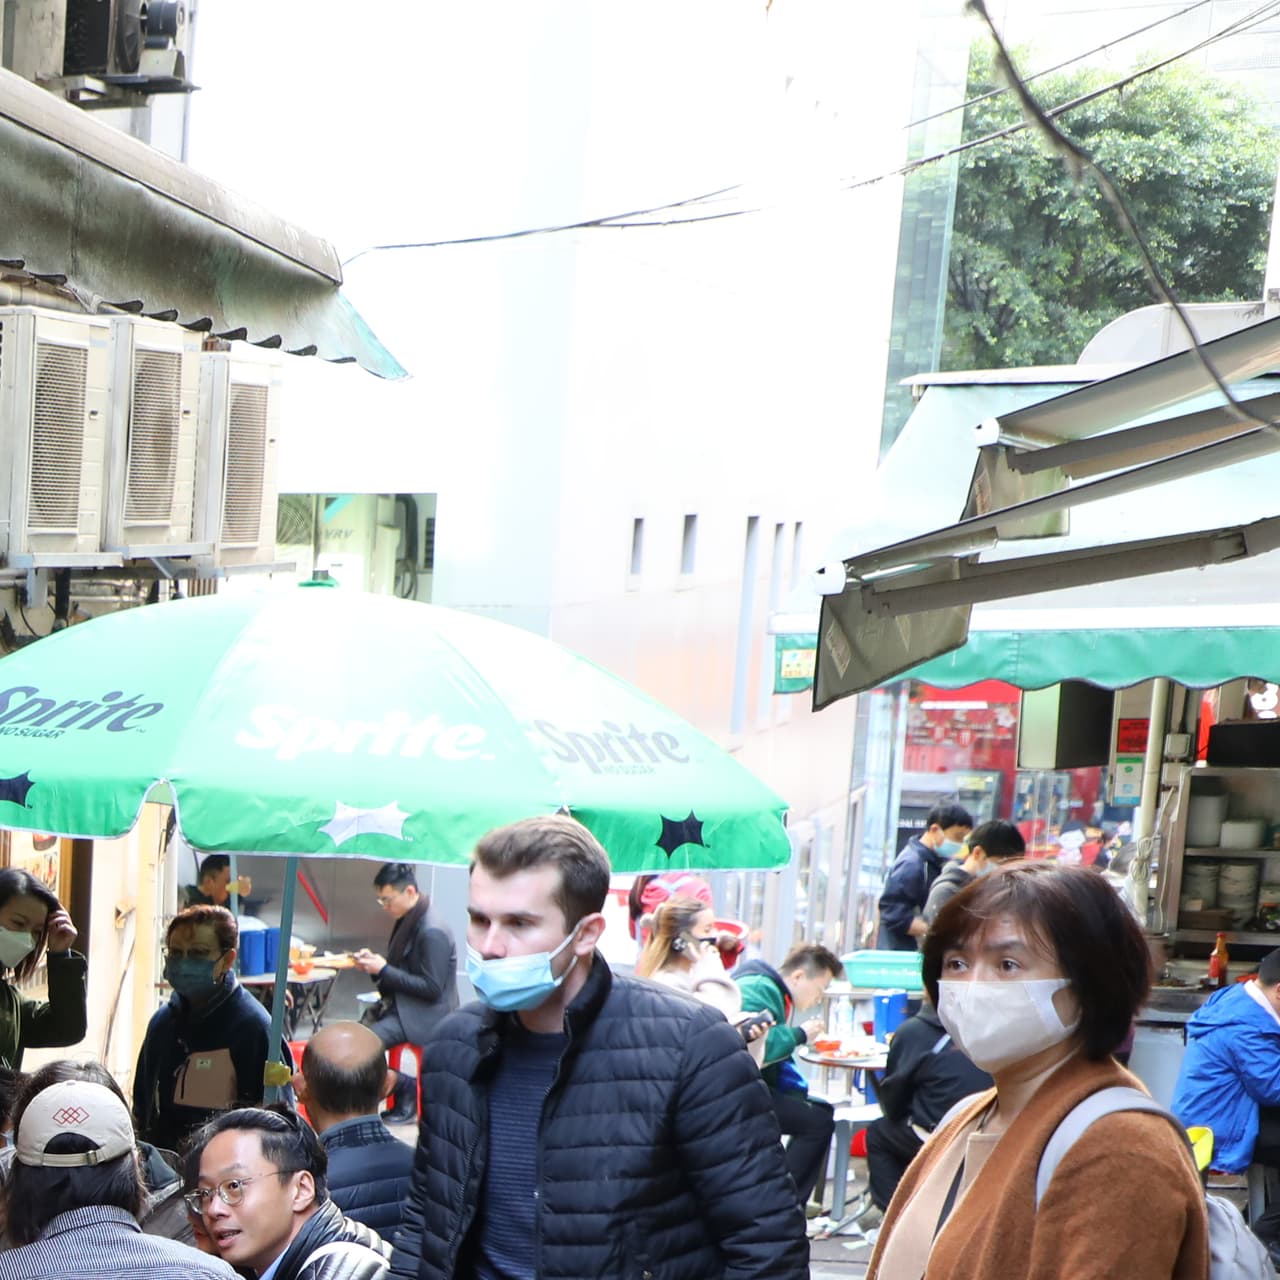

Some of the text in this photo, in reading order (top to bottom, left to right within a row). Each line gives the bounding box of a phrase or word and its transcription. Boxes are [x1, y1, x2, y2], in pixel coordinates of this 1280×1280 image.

[14, 727, 66, 740] SUGAR
[235, 705, 488, 761] Sprite
[534, 718, 690, 774] Sprite
